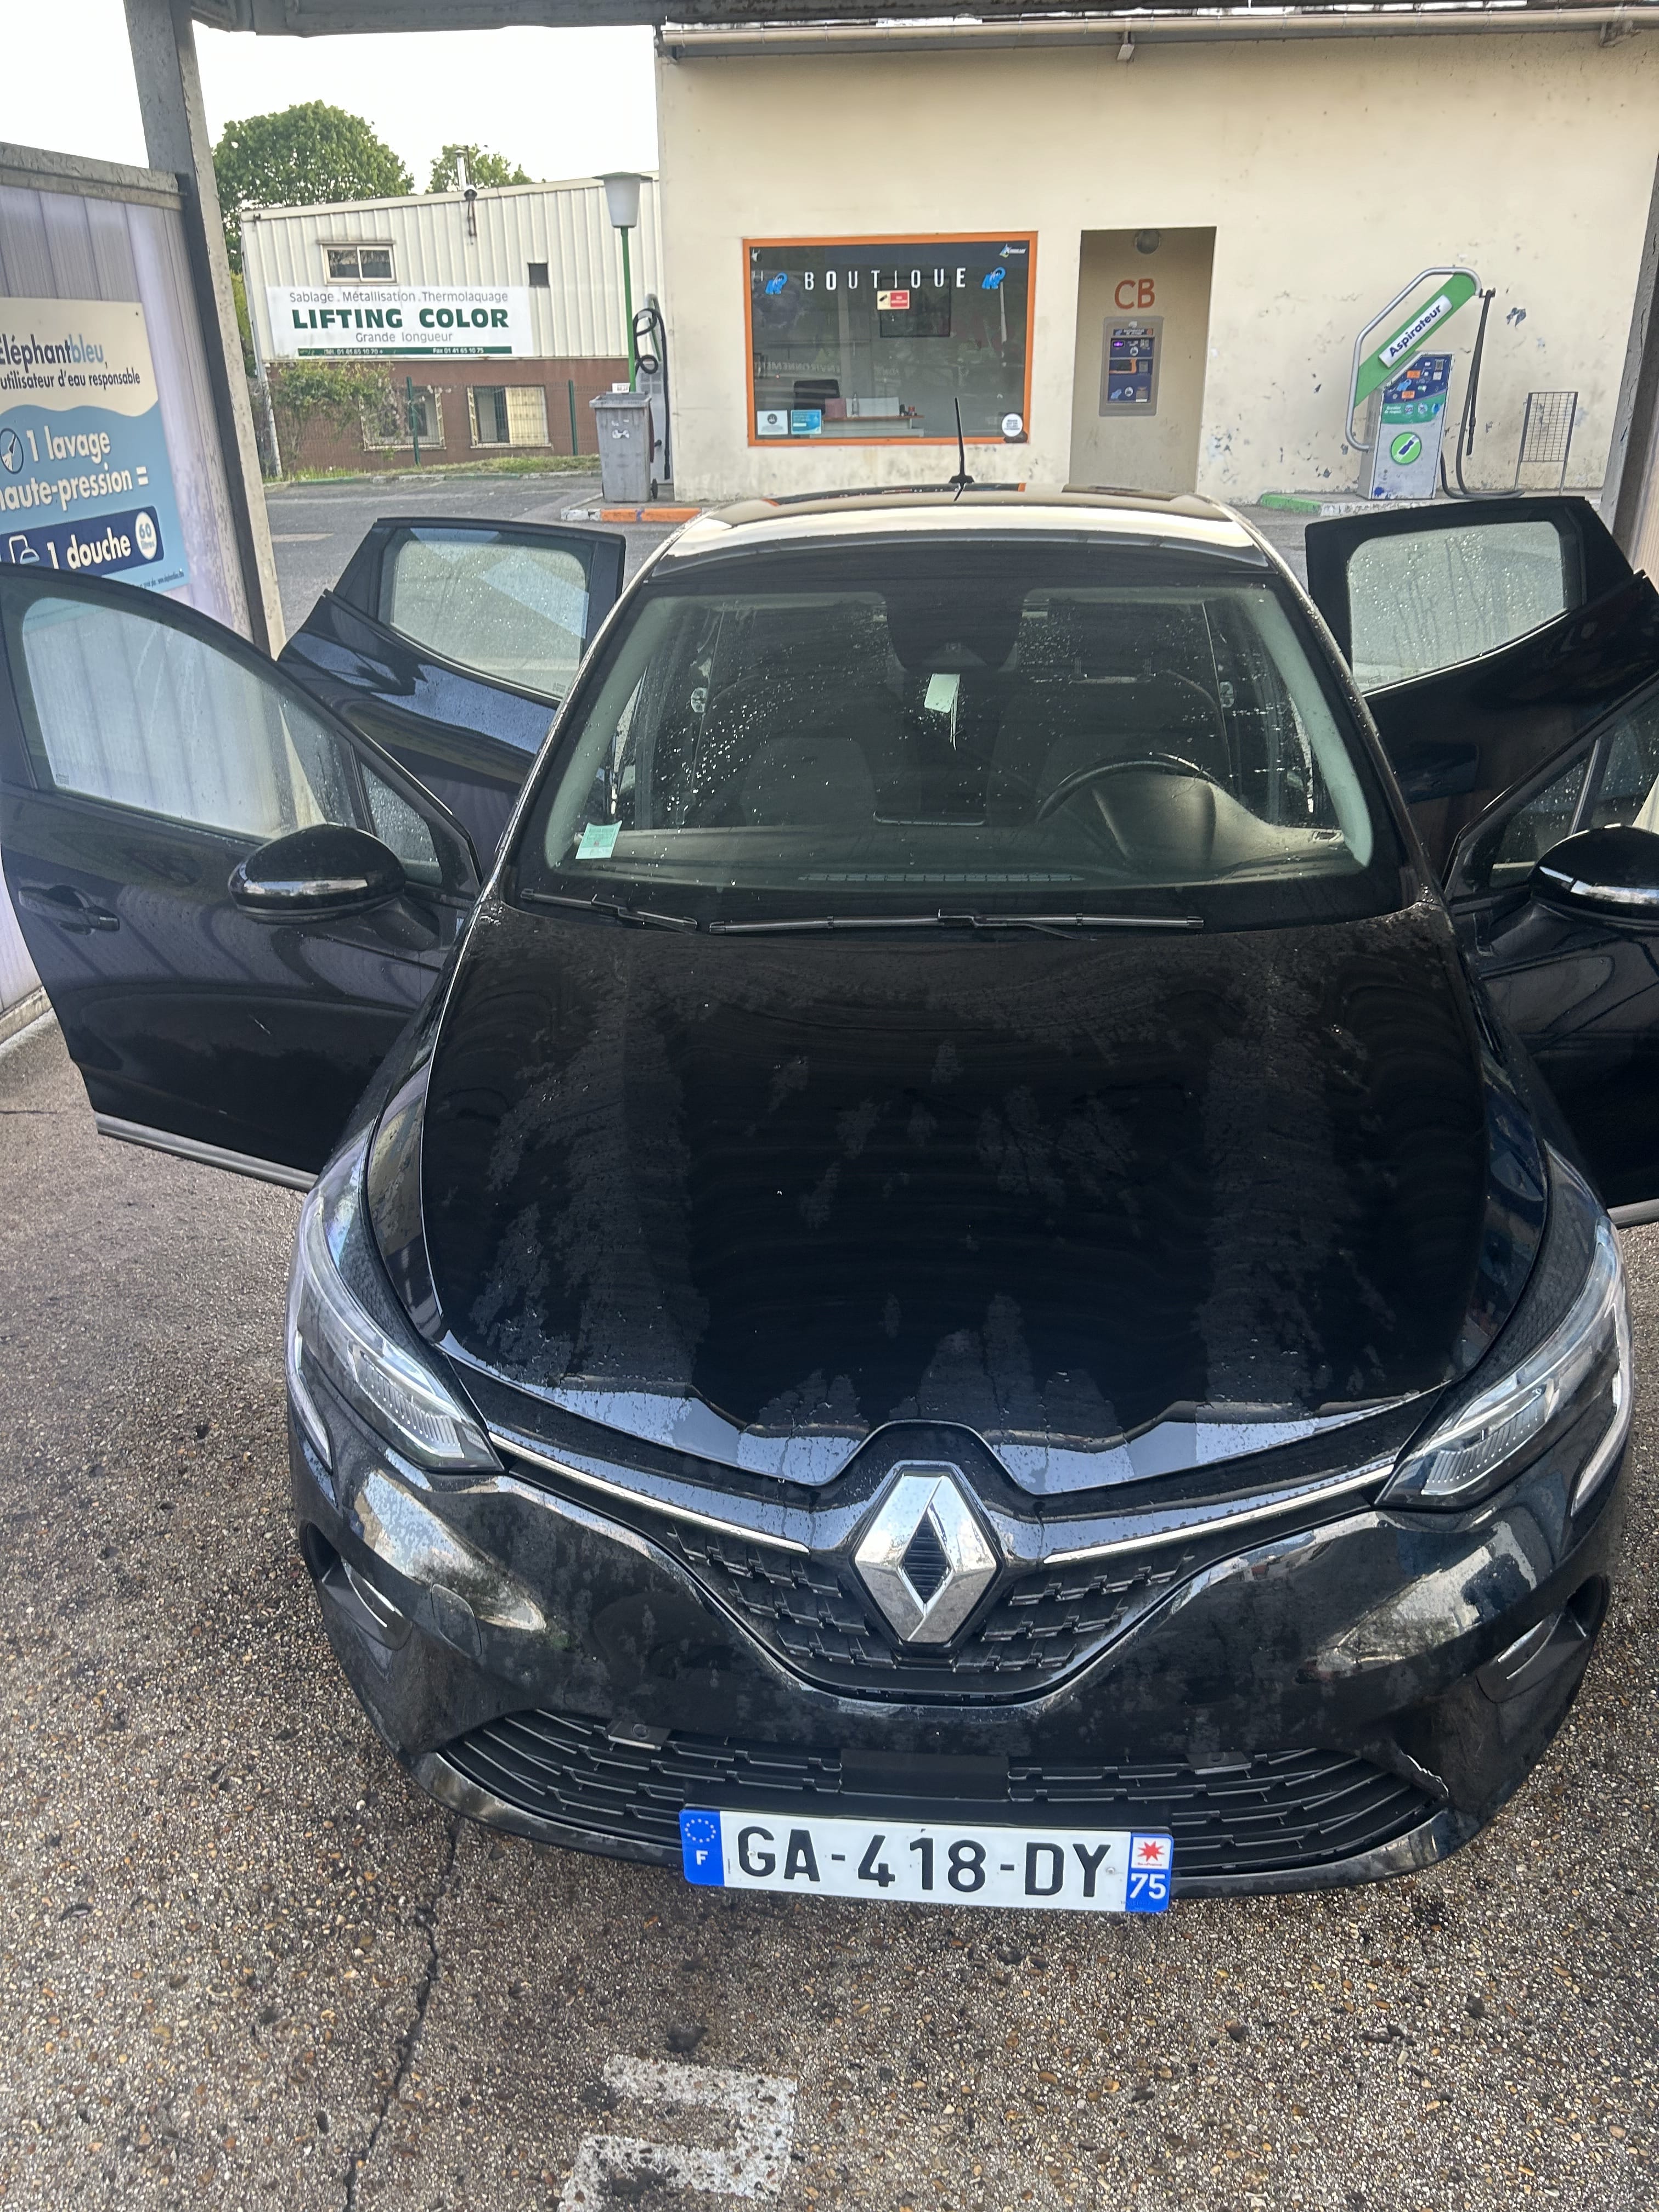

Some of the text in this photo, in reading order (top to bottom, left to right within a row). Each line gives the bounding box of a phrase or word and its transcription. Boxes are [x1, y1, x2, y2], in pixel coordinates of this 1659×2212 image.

[804, 268, 966, 290] BOUTIQUE
[290, 291, 508, 303] Sablage Métallisation Thermolaquage
[1114, 278, 1155, 309] CB
[292, 308, 509, 329] LIFTING COLOR
[356, 332, 453, 343] Grande longueur
[1390, 305, 1441, 357] Aspirateur
[0, 367, 140, 390] utilisateur d'eau responsable
[26, 425, 111, 464] 1 lavage
[139, 523, 152, 539] 60
[47, 527, 131, 570] 1 douche
[696, 1849, 708, 1865] F
[737, 1826, 1111, 1898] GA-418-DY
[1130, 1872, 1166, 1900] 75
